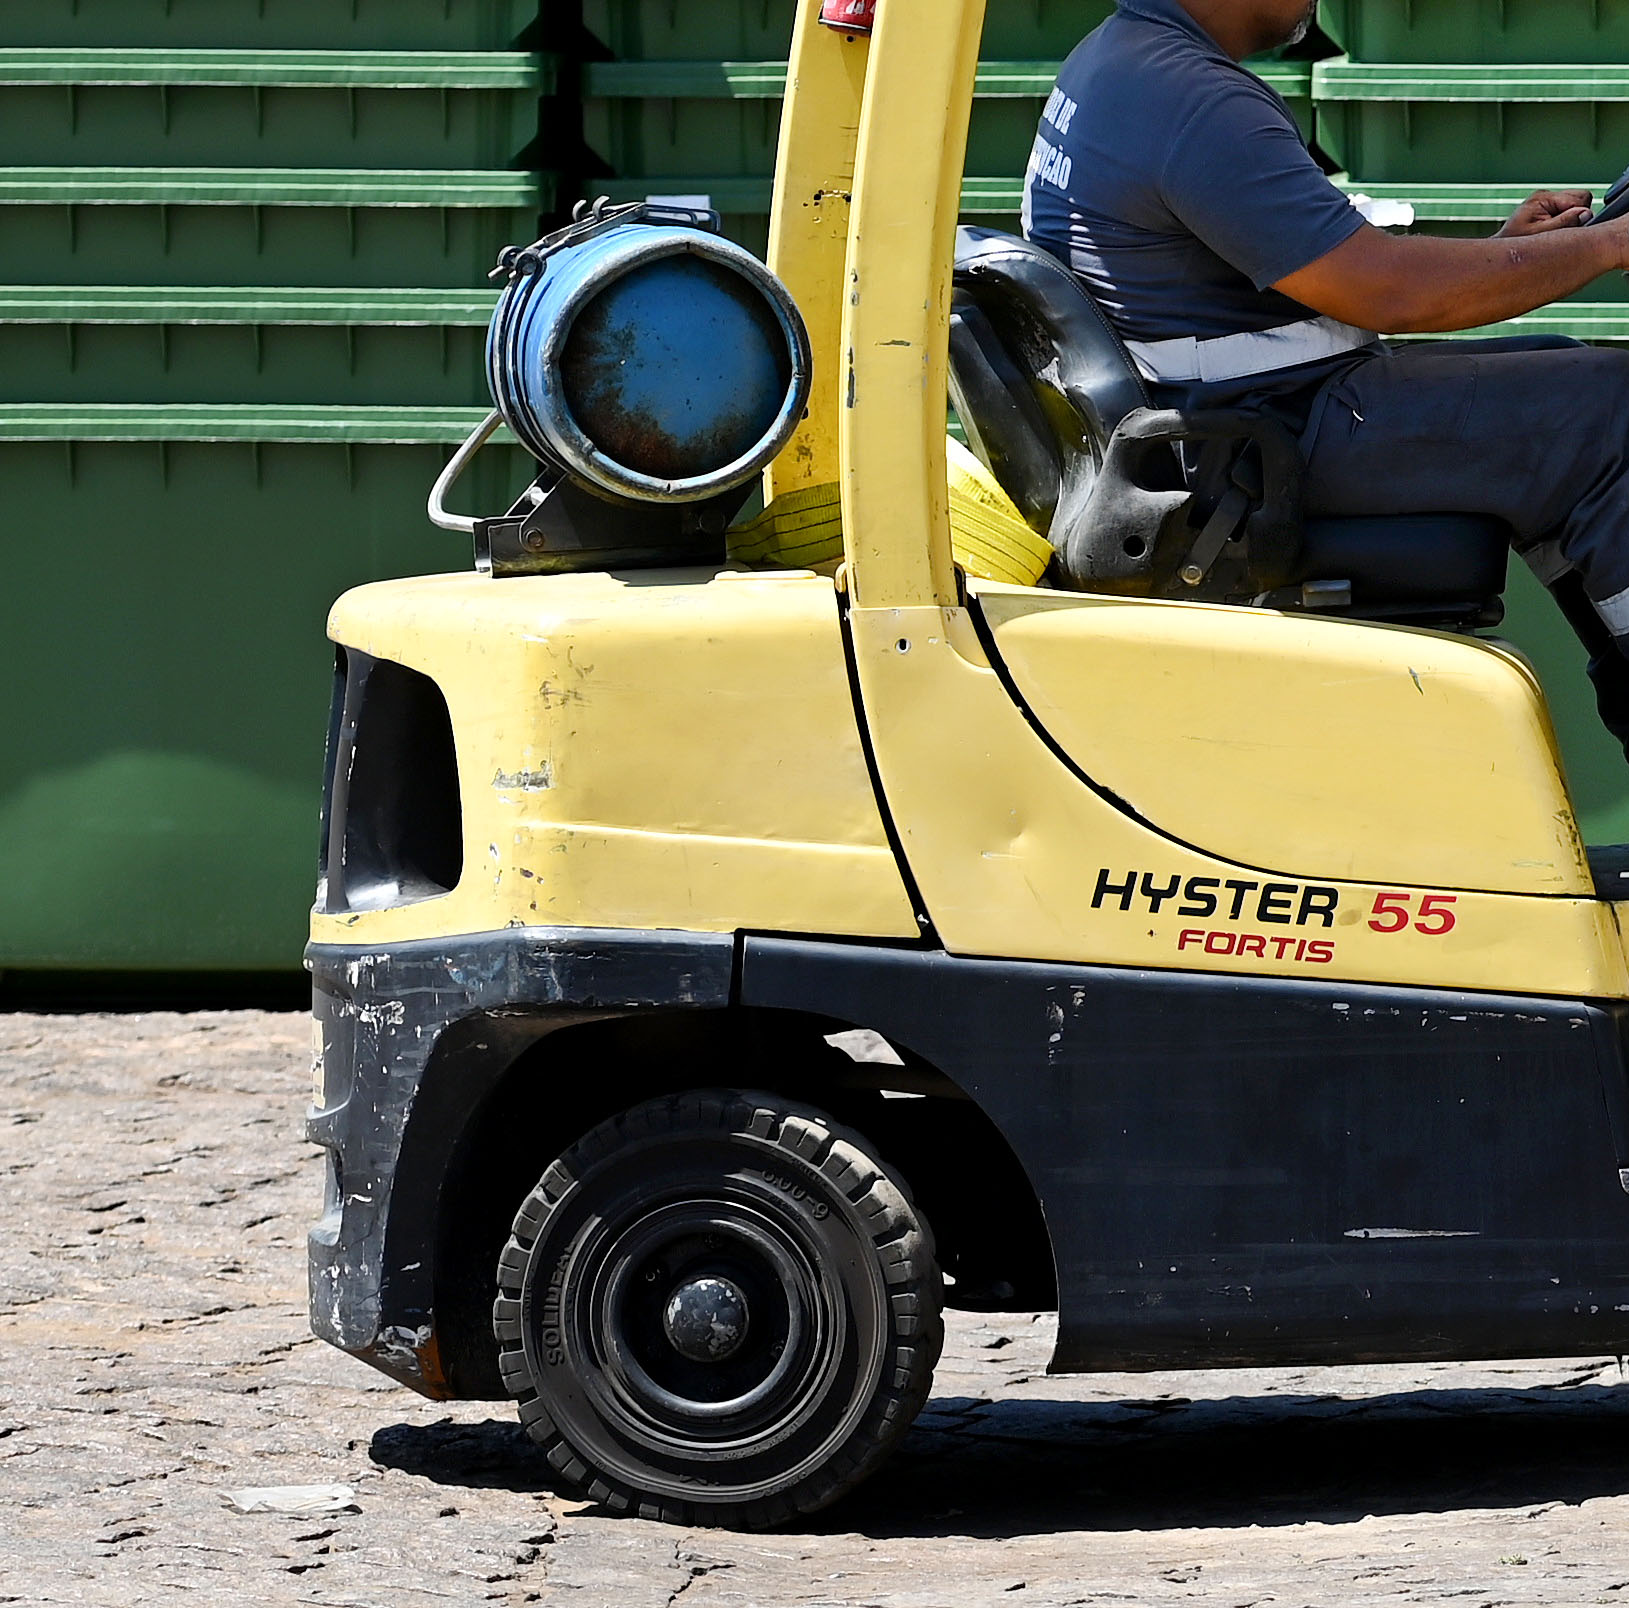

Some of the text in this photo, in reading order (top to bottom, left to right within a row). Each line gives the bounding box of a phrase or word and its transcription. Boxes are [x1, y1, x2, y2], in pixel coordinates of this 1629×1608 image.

[1090, 868, 1458, 935] HYSTER 55
[1177, 929, 1336, 964] FORTIS
